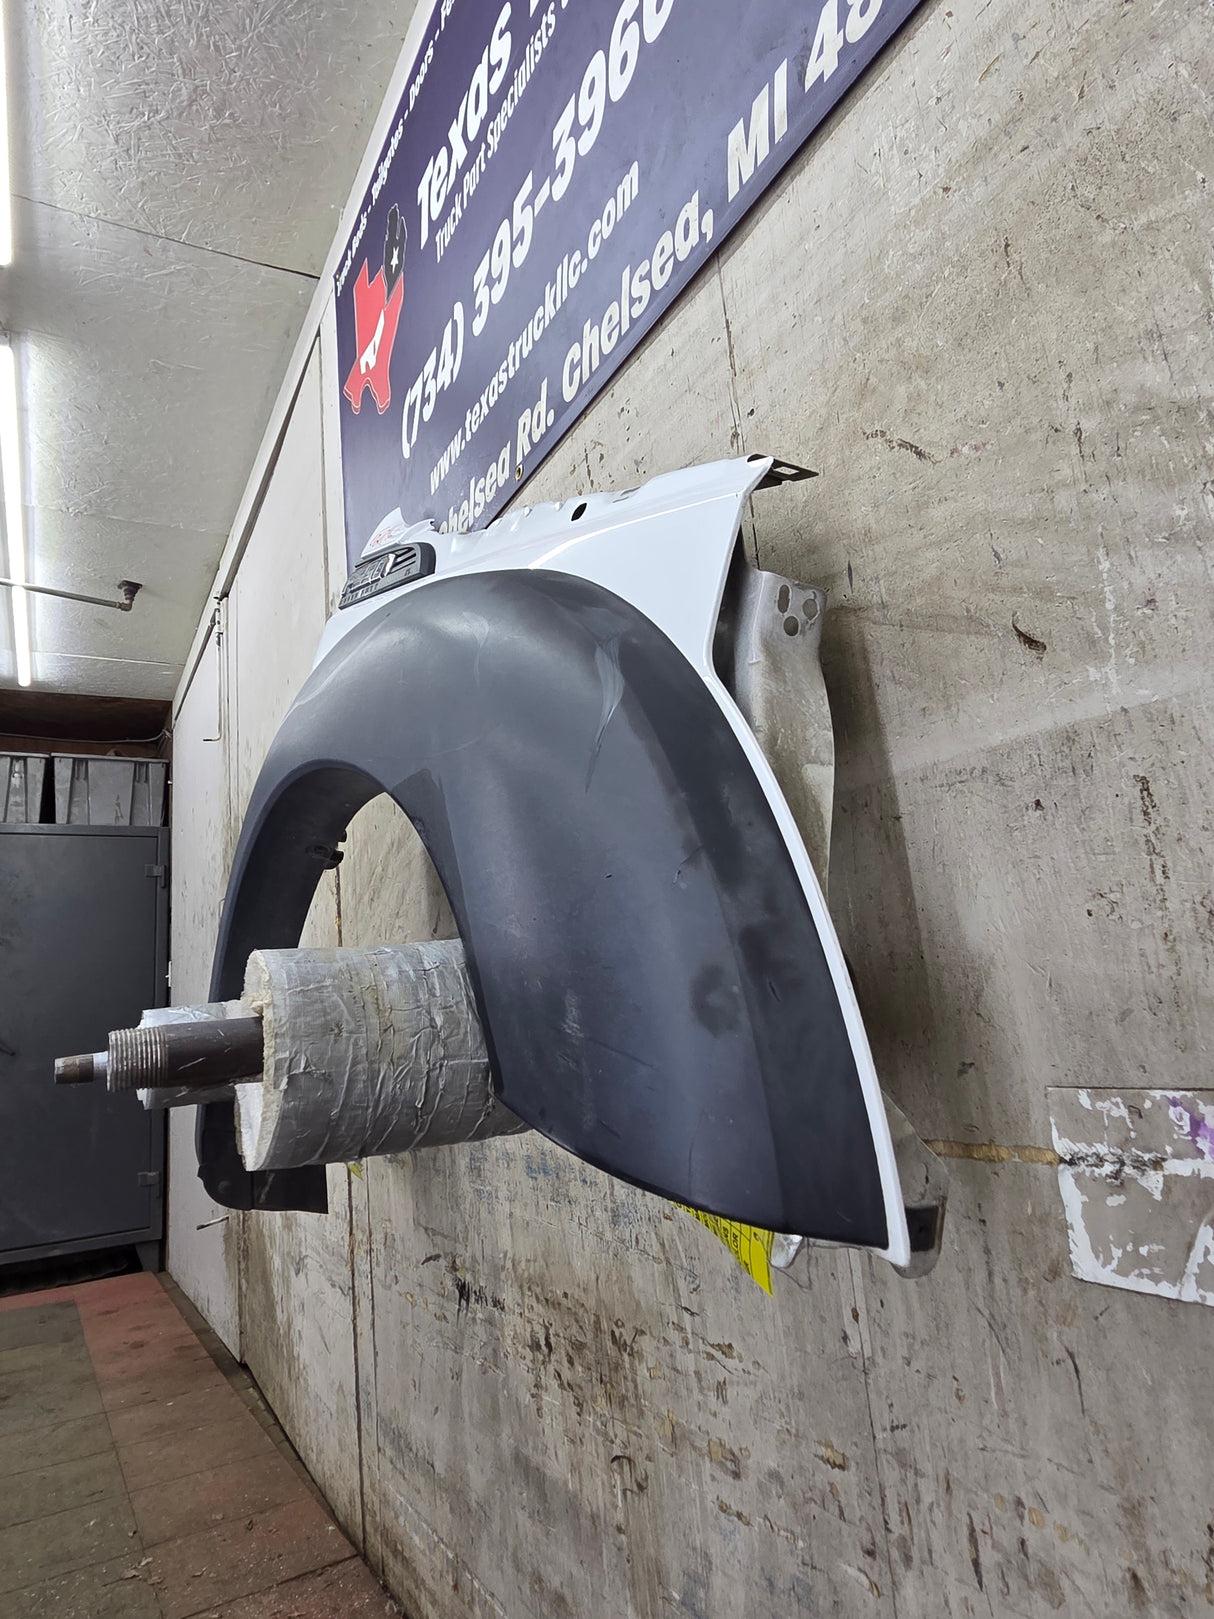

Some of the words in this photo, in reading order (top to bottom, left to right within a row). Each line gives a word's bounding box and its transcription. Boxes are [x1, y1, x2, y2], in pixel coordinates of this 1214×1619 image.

[409, 40, 434, 112] Doors
[417, 2, 512, 250] Texas
[435, 193, 463, 264] Truck
[464, 143, 486, 210] Part
[487, 2, 556, 159] Specialists
[402, 302, 465, 460] (734)
[430, 161, 639, 497] www.texastruckllc.com
[516, 377, 555, 466] Rd.
[563, 190, 714, 403] Chelsea,
[727, 58, 788, 203] MI
